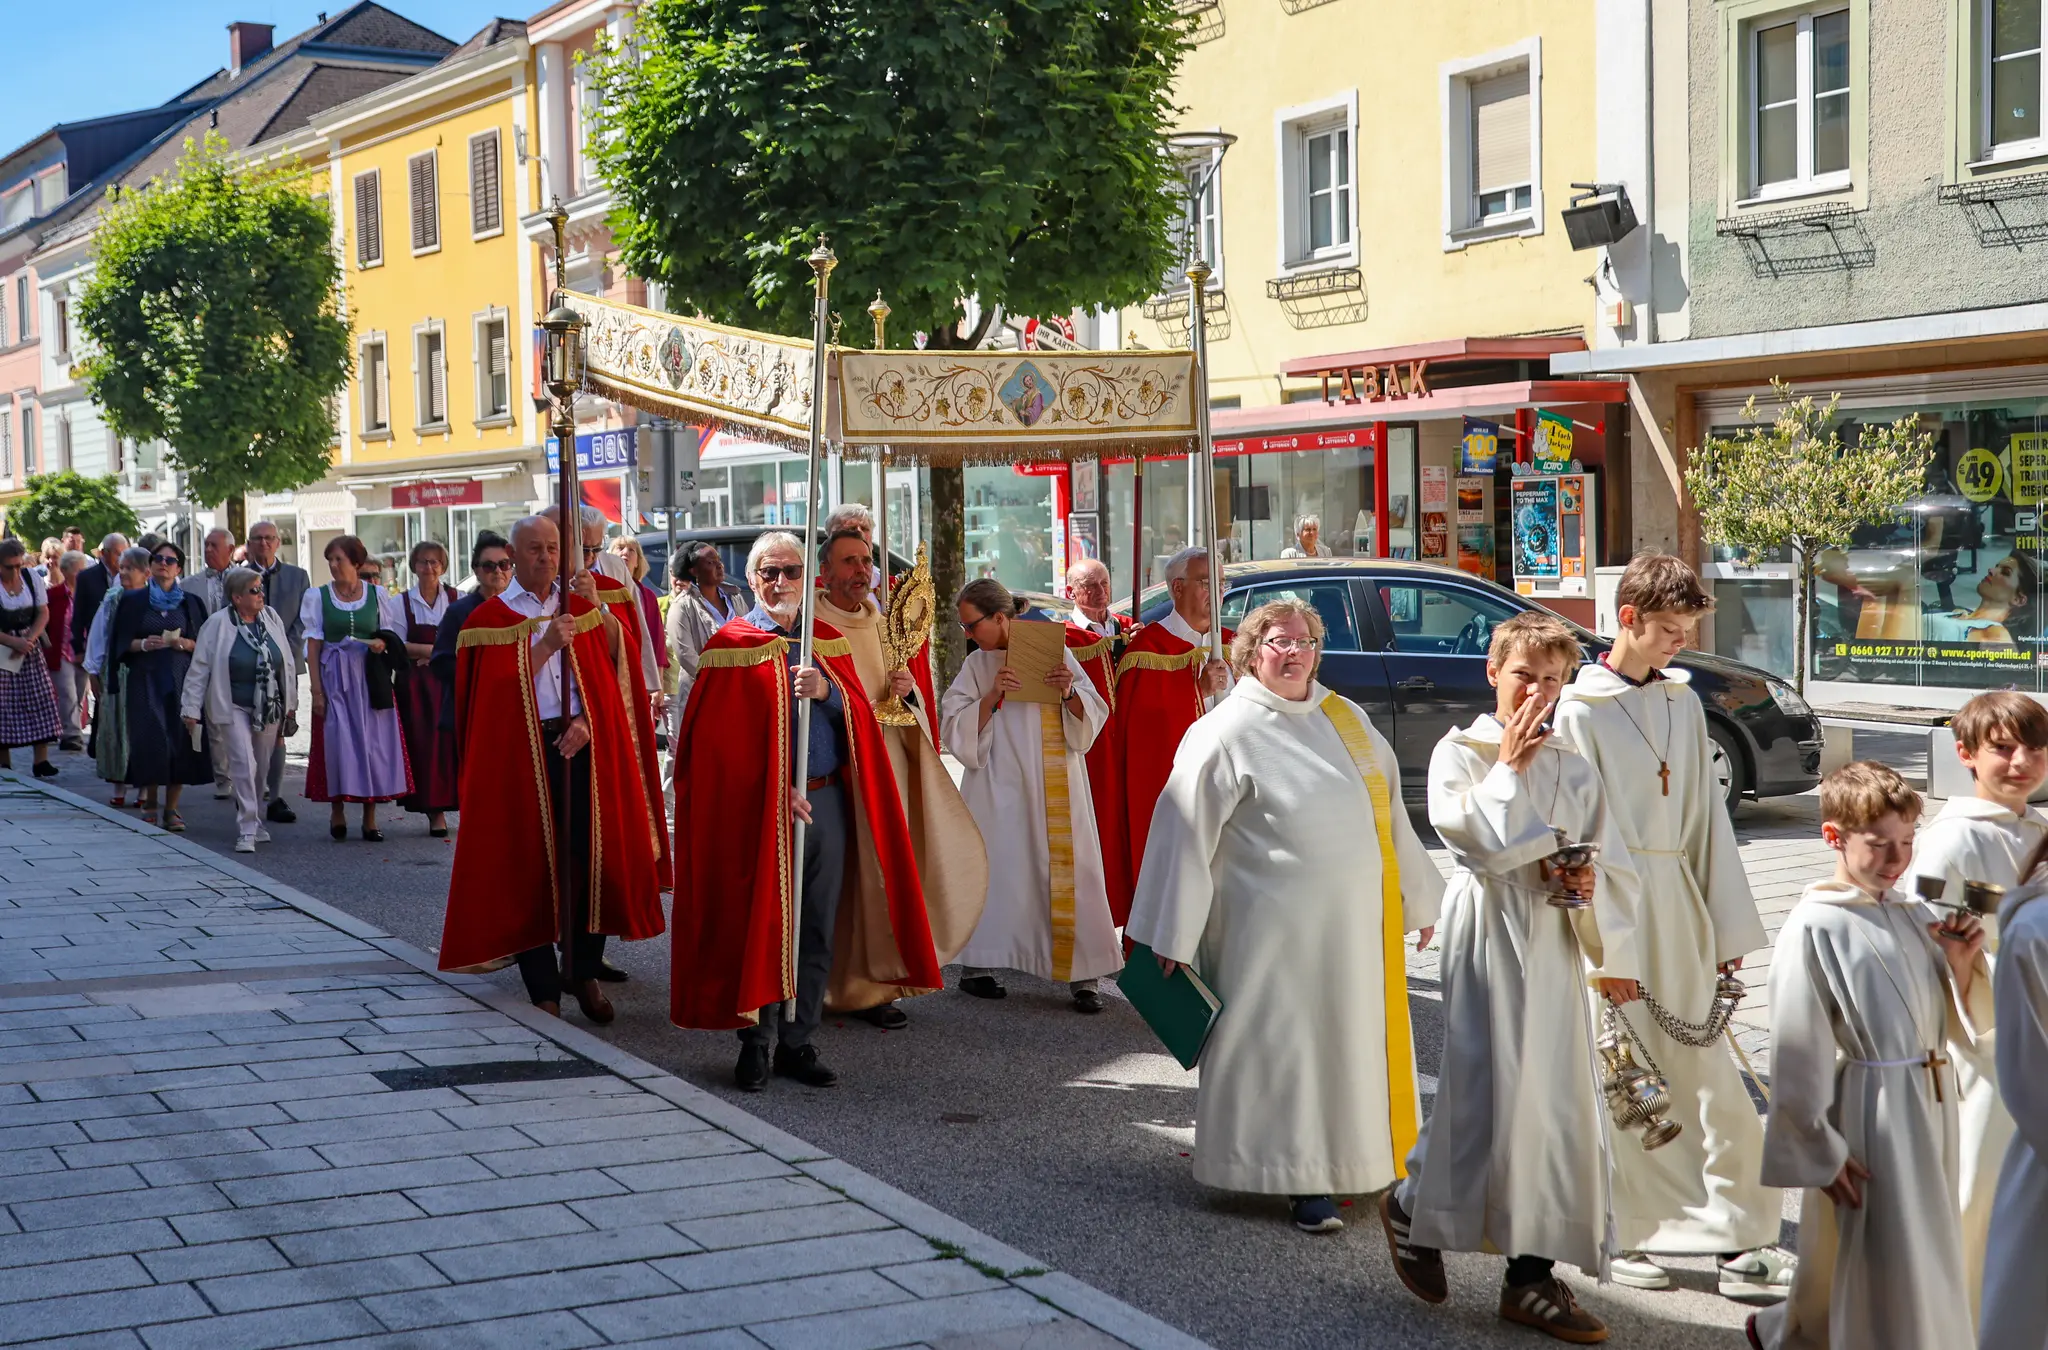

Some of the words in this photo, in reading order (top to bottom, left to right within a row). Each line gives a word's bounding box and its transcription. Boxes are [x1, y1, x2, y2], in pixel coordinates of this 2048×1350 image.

[1037, 328, 1051, 341] IHR
[1317, 360, 1427, 402] TABAK
[1463, 433, 1498, 456] 100
[1548, 438, 1571, 451] Jackpot
[1543, 461, 1563, 471] LOTTO
[2019, 455, 2048, 467] SEPER
[1965, 461, 1995, 489] 49
[2020, 470, 2048, 482] TRAIN
[1851, 646, 1873, 655] 0660
[1875, 646, 1892, 656] 927
[1895, 647, 1906, 656] 17
[1907, 646, 1925, 657] 777
[1941, 649, 2031, 661] www.sportgorilla.at
